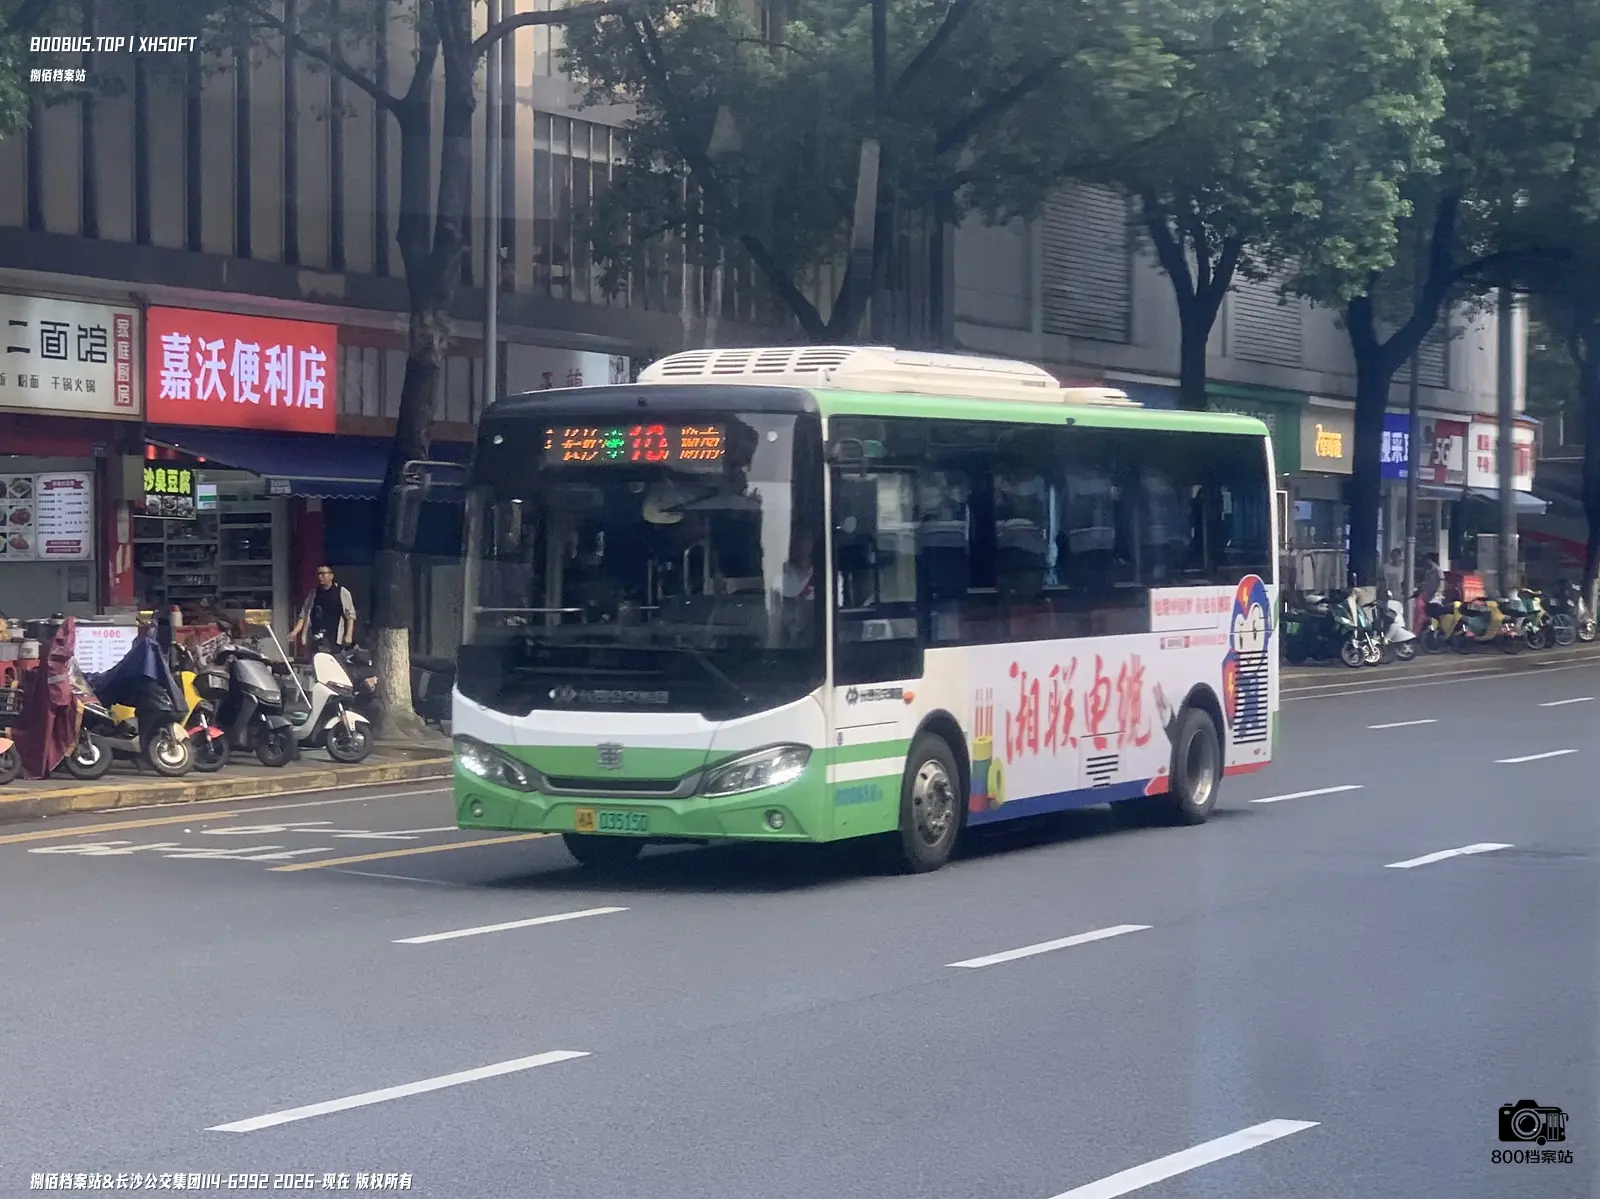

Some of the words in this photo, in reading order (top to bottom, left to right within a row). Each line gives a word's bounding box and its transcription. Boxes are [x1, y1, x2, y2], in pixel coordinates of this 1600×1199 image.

[51, 376, 96, 393] 干锅火锅
[159, 331, 327, 410] 嘉沃便利店
[1006, 654, 1151, 765] 湘联电缆
